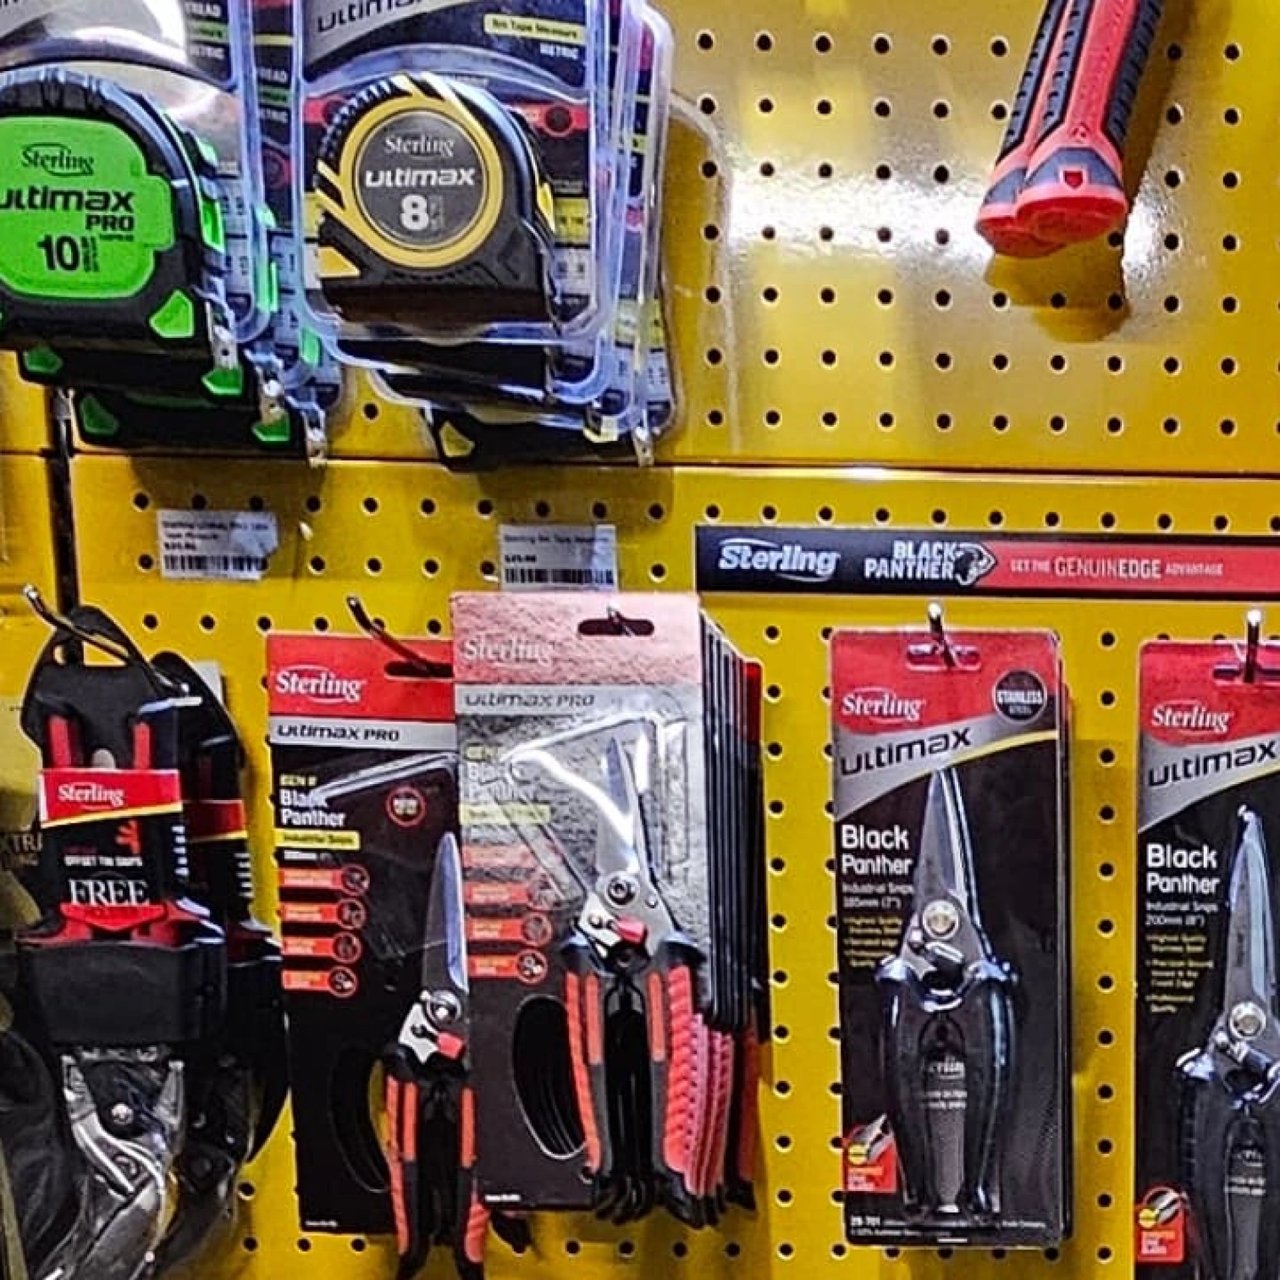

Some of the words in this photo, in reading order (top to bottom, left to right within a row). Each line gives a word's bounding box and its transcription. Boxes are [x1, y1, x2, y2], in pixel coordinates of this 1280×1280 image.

[318, 0, 424, 33] ultim
[384, 136, 455, 157] Sterling
[21, 145, 95, 176] Sterling
[366, 168, 476, 188] ultimax
[85, 215, 134, 232] PRO
[401, 195, 430, 231] 8
[38, 234, 82, 273] 10
[719, 543, 840, 577] Sterling
[893, 541, 957, 561] BLACK
[865, 560, 954, 579] PANTHER
[463, 637, 553, 664] Sterling
[276, 668, 362, 701] Sterling
[465, 692, 553, 708] ultimax
[556, 696, 595, 708] PRO
[842, 691, 922, 720] Sterling
[1151, 704, 1232, 734] Sterling
[278, 724, 358, 740] ultimax
[363, 729, 400, 742] PRO
[840, 727, 973, 777] ultimax
[1148, 741, 1277, 787] ultimax
[58, 783, 125, 806] Sterling
[281, 808, 346, 827] Panther
[841, 824, 910, 850] Black
[841, 854, 914, 876] Panther
[1146, 843, 1217, 869] Black
[69, 879, 149, 906] FREE
[1146, 873, 1219, 894] Panther
